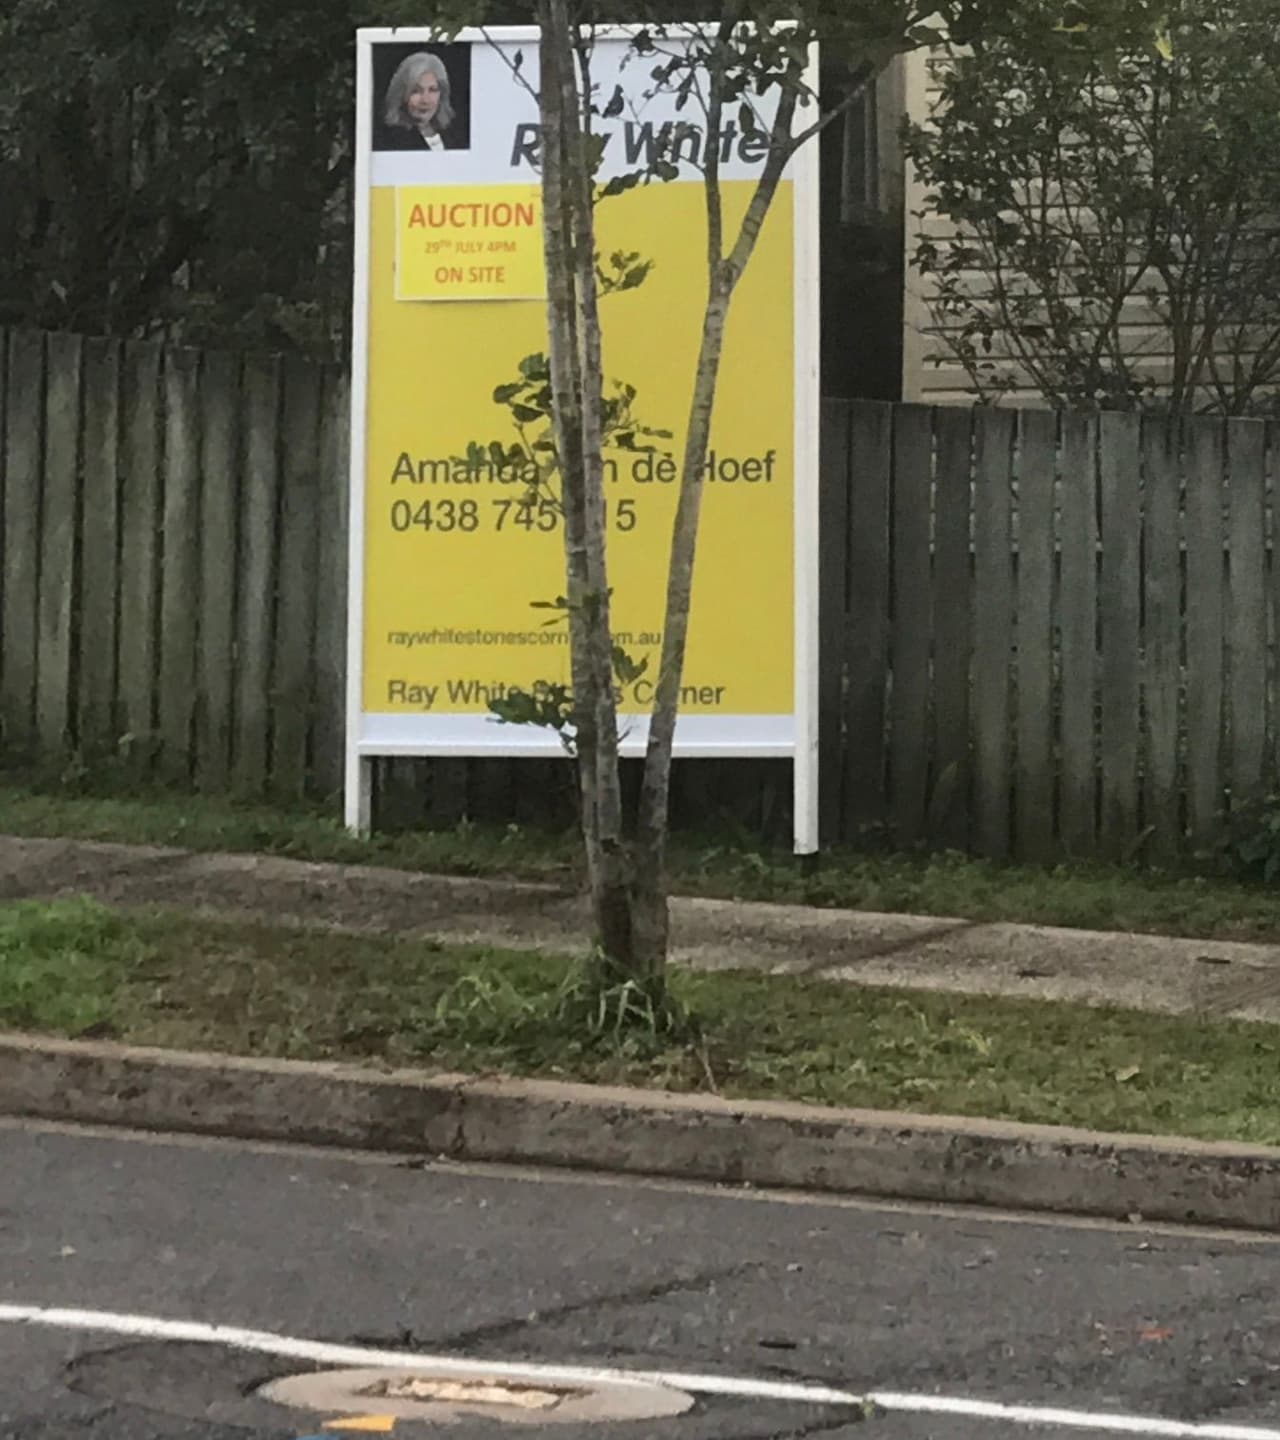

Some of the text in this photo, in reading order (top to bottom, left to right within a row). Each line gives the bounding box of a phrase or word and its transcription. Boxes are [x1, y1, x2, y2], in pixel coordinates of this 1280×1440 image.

[624, 121, 769, 165] Whte
[408, 203, 534, 228] AUCTION
[434, 267, 505, 284] ON SITE
[632, 449, 677, 483] de
[391, 499, 479, 532] 0438
[492, 499, 557, 532] 745
[388, 680, 438, 710] Ray
[633, 680, 725, 705] Cner
